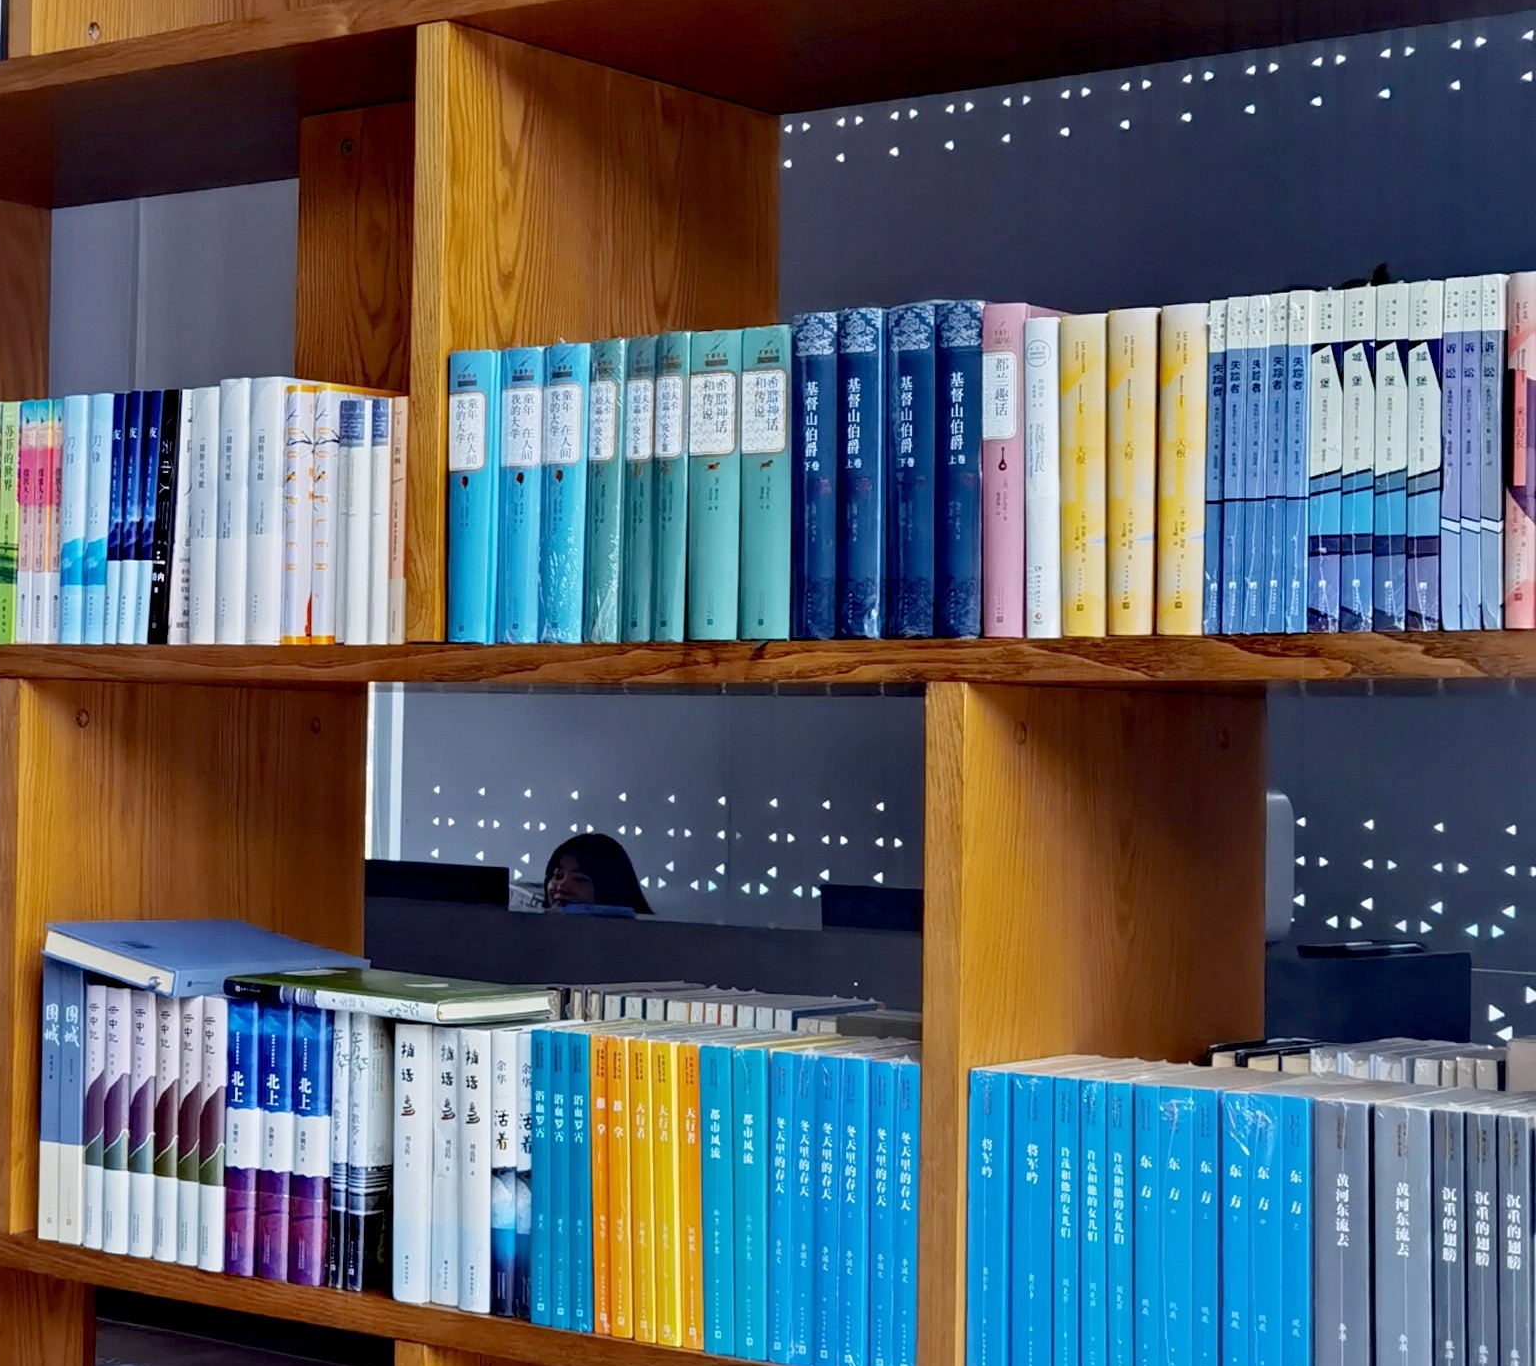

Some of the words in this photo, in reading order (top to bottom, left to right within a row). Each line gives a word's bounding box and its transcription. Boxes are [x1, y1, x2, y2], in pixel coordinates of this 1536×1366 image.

[994, 357, 1009, 417] 都兰趣话
[1212, 363, 1224, 397] 失踪者
[1230, 360, 1241, 395] 失踪者
[1252, 359, 1261, 393] 失踪者
[1273, 356, 1284, 390] 失踪者
[1292, 356, 1303, 390] 失踪者
[467, 398, 477, 420] 童年
[510, 393, 521, 440] 我的大学
[523, 394, 534, 416] 童年
[549, 390, 560, 437] 我的大学
[561, 390, 573, 412] 童年
[702, 381, 715, 420] 和传说
[715, 380, 728, 433] 希腊神话
[754, 376, 766, 418] 和传说
[766, 375, 779, 431] 希腊神话
[805, 381, 819, 457] 基督山伯爵
[847, 378, 861, 456] 基督山伯爵
[900, 376, 913, 454] 基督山伯爵
[950, 372, 964, 450] 基督山伯爵
[455, 399, 465, 445] 我的大学
[560, 424, 572, 459] 在人间
[3, 421, 14, 491] 苏菲的世界
[466, 431, 477, 464] 在人间
[521, 428, 533, 462] 在人间
[804, 461, 820, 471] 下卷
[846, 458, 862, 469] 上卷
[898, 456, 915, 468] 下卷
[948, 454, 966, 465] 上卷
[44, 1004, 60, 1046] 围城
[64, 1005, 80, 1047] 围城
[231, 1071, 245, 1103] 北上
[266, 1074, 280, 1106] 北上
[298, 1078, 312, 1111] 北上
[497, 1060, 506, 1085] 余华
[495, 1110, 509, 1151] 活着
[519, 1113, 532, 1154] 活着
[636, 1103, 645, 1140] 天行者
[659, 1105, 668, 1142] 天行者
[686, 1108, 696, 1144] 天行者
[710, 1109, 721, 1159] 都市风流
[743, 1114, 754, 1165] 都市风流
[774, 1117, 786, 1194] 冬天里的春天
[799, 1120, 810, 1197] 冬天里的春天
[821, 1122, 833, 1200] 冬天里的春天
[845, 1125, 856, 1204] 冬天里的春天
[875, 1128, 887, 1207] 冬天里的春天
[900, 1132, 912, 1211] 冬天里的春天
[981, 1137, 993, 1179] 将军吟
[1026, 1143, 1039, 1184] 将军吟
[1140, 1154, 1152, 1199] 东方
[1060, 1146, 1071, 1239] 许茂和他的女儿们
[1087, 1149, 1098, 1242] 许茂和他的女儿们
[1113, 1152, 1124, 1245] 许茂和他的女儿们
[1168, 1157, 1181, 1201] 东方
[1200, 1160, 1212, 1204] 东方
[1229, 1164, 1242, 1209] 东方
[1257, 1166, 1270, 1211] 东方
[1290, 1170, 1303, 1214] 东方
[1335, 1173, 1350, 1247] 黄河东流去
[1395, 1182, 1410, 1257] 黄河东流去
[1442, 1187, 1457, 1263] 沉重的翅膀
[1474, 1191, 1490, 1267] 沉重的翅膀
[1506, 1194, 1521, 1270] 沉重的翅膀
